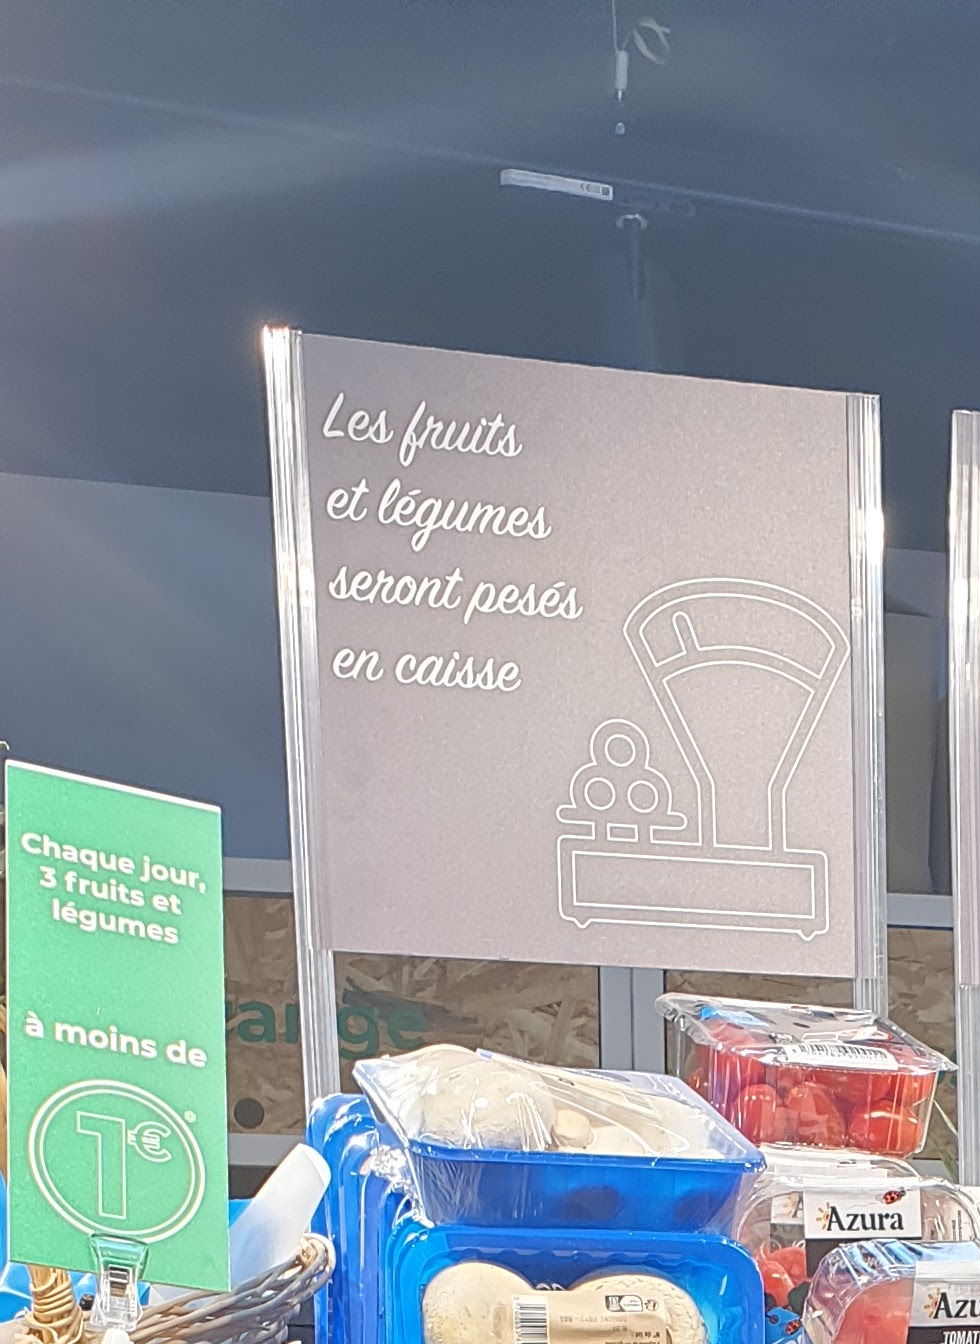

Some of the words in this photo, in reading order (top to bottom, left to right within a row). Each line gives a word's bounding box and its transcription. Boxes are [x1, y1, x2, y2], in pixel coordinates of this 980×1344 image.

[322, 392, 393, 445] Les
[399, 401, 523, 466] fruits
[327, 478, 367, 522] et
[378, 478, 551, 551] légumes
[329, 567, 462, 609] seront
[464, 579, 584, 623] pesés
[333, 645, 383, 681] en
[395, 648, 522, 691] caisse
[21, 833, 135, 878] Chaque
[140, 856, 206, 894] jour,
[39, 866, 57, 888] 3
[64, 871, 145, 907] fruits
[152, 894, 182, 915] et
[52, 898, 178, 944] légumes
[24, 1011, 44, 1038] à
[55, 1019, 157, 1059] moins
[166, 1040, 208, 1069] de
[827, 1207, 904, 1232] Azura
